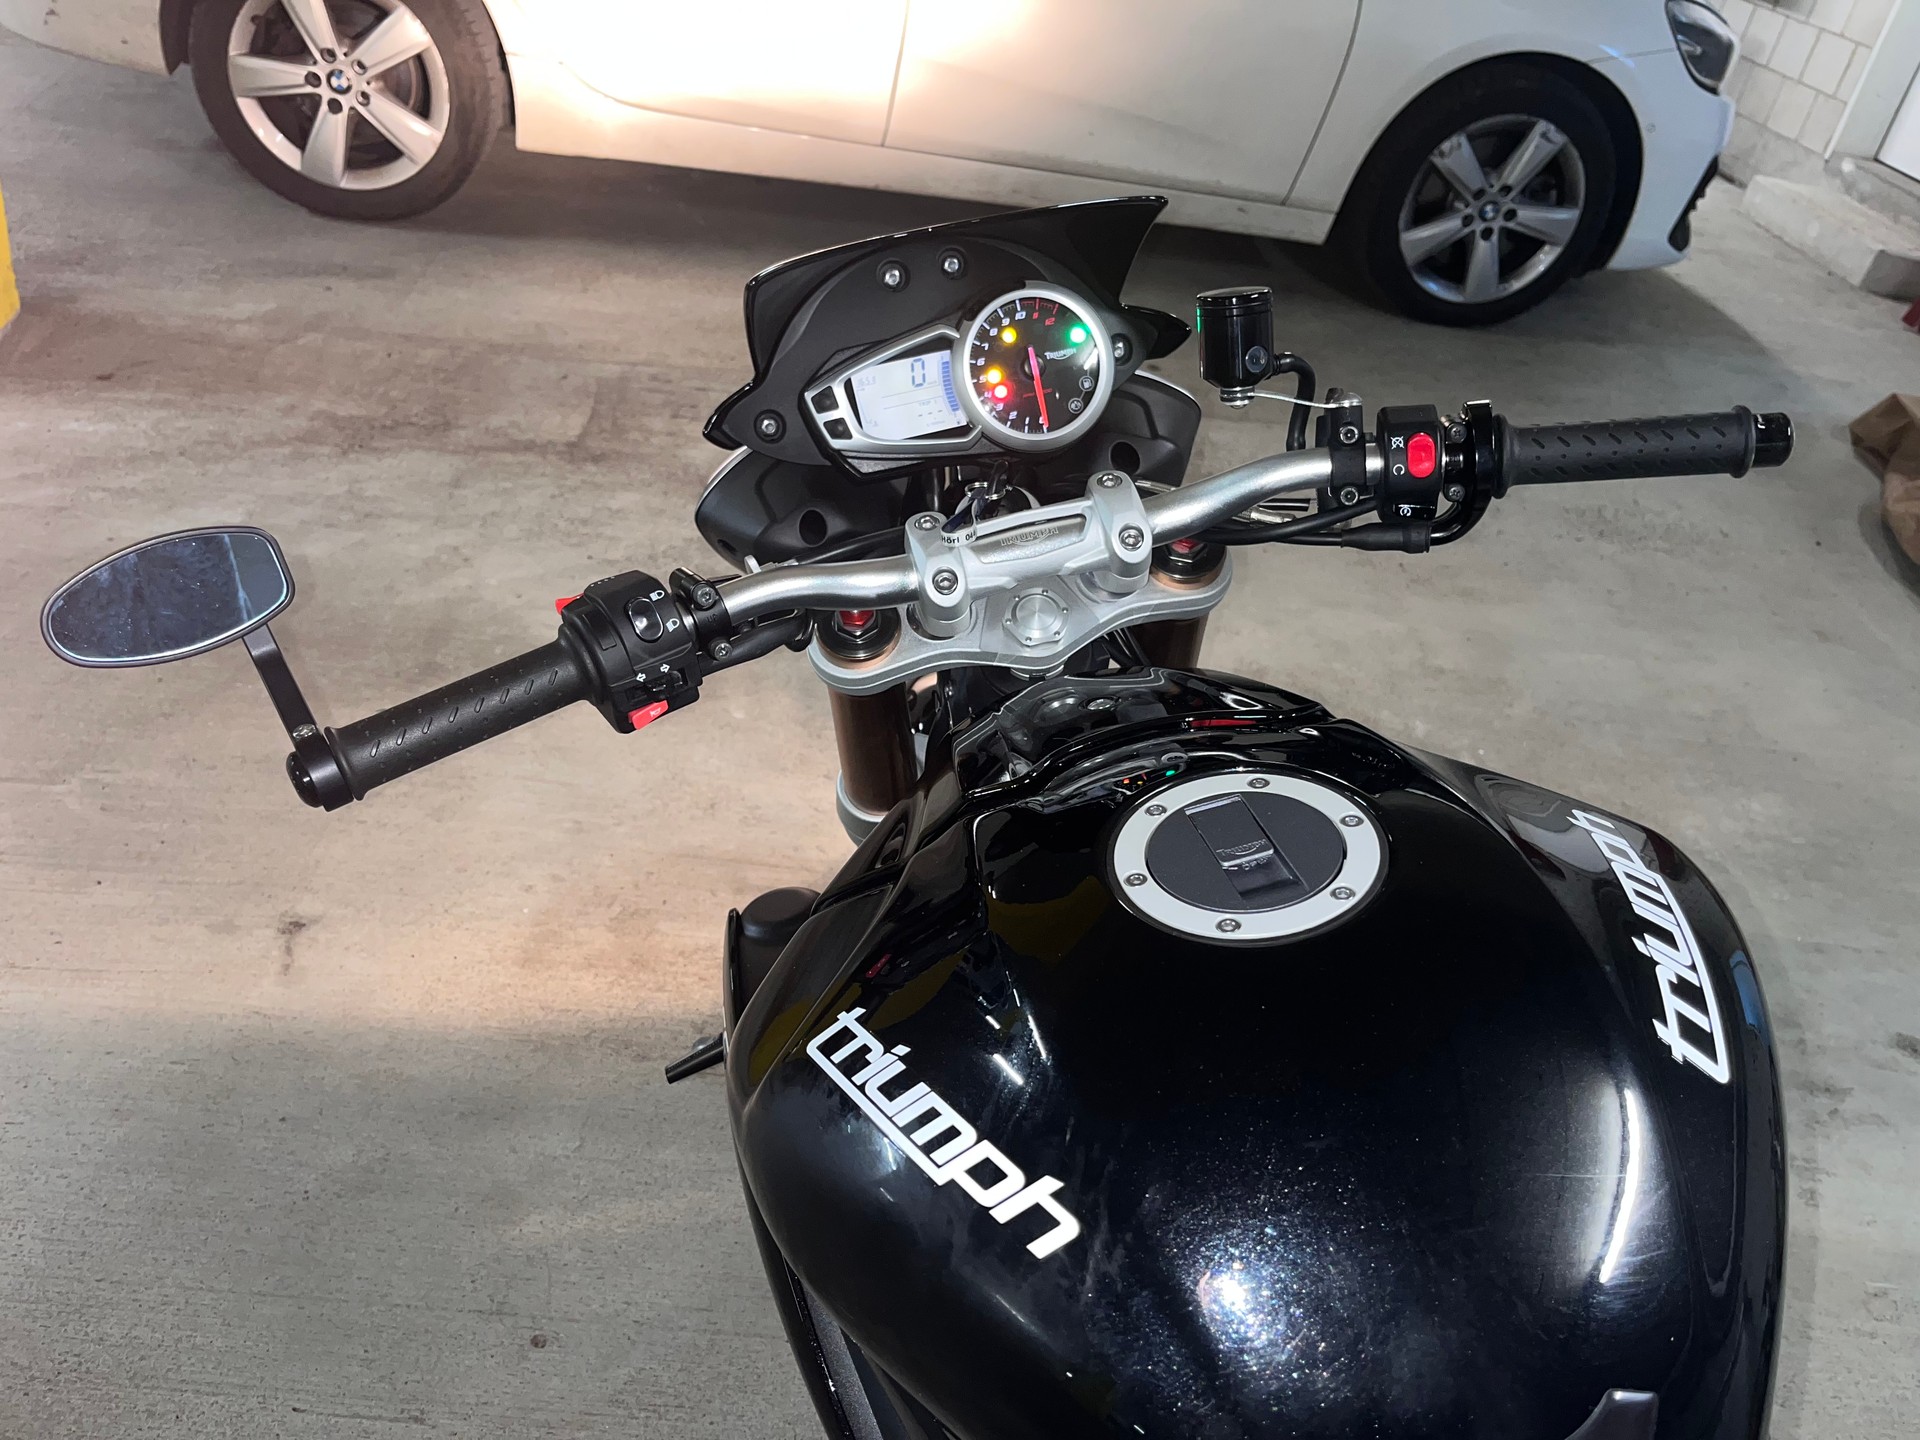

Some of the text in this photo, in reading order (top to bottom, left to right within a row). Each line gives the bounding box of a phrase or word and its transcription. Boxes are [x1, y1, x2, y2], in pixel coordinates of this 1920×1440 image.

[1015, 311, 1026, 321] 10
[1001, 317, 1010, 327] 9
[1045, 317, 1056, 326] 12
[989, 327, 998, 337] 8
[981, 343, 989, 351] 7
[1043, 347, 1077, 360] TRIUMPH
[976, 357, 986, 366] 6
[911, 357, 926, 389] 0
[979, 375, 988, 384] 5
[984, 391, 993, 399] 4
[1008, 411, 1018, 420] 2
[1024, 416, 1030, 425] 1
[941, 535, 960, 545] Hörl
[1000, 526, 1060, 548] TRIUMPH
[1215, 838, 1269, 857] TRIUMPH
